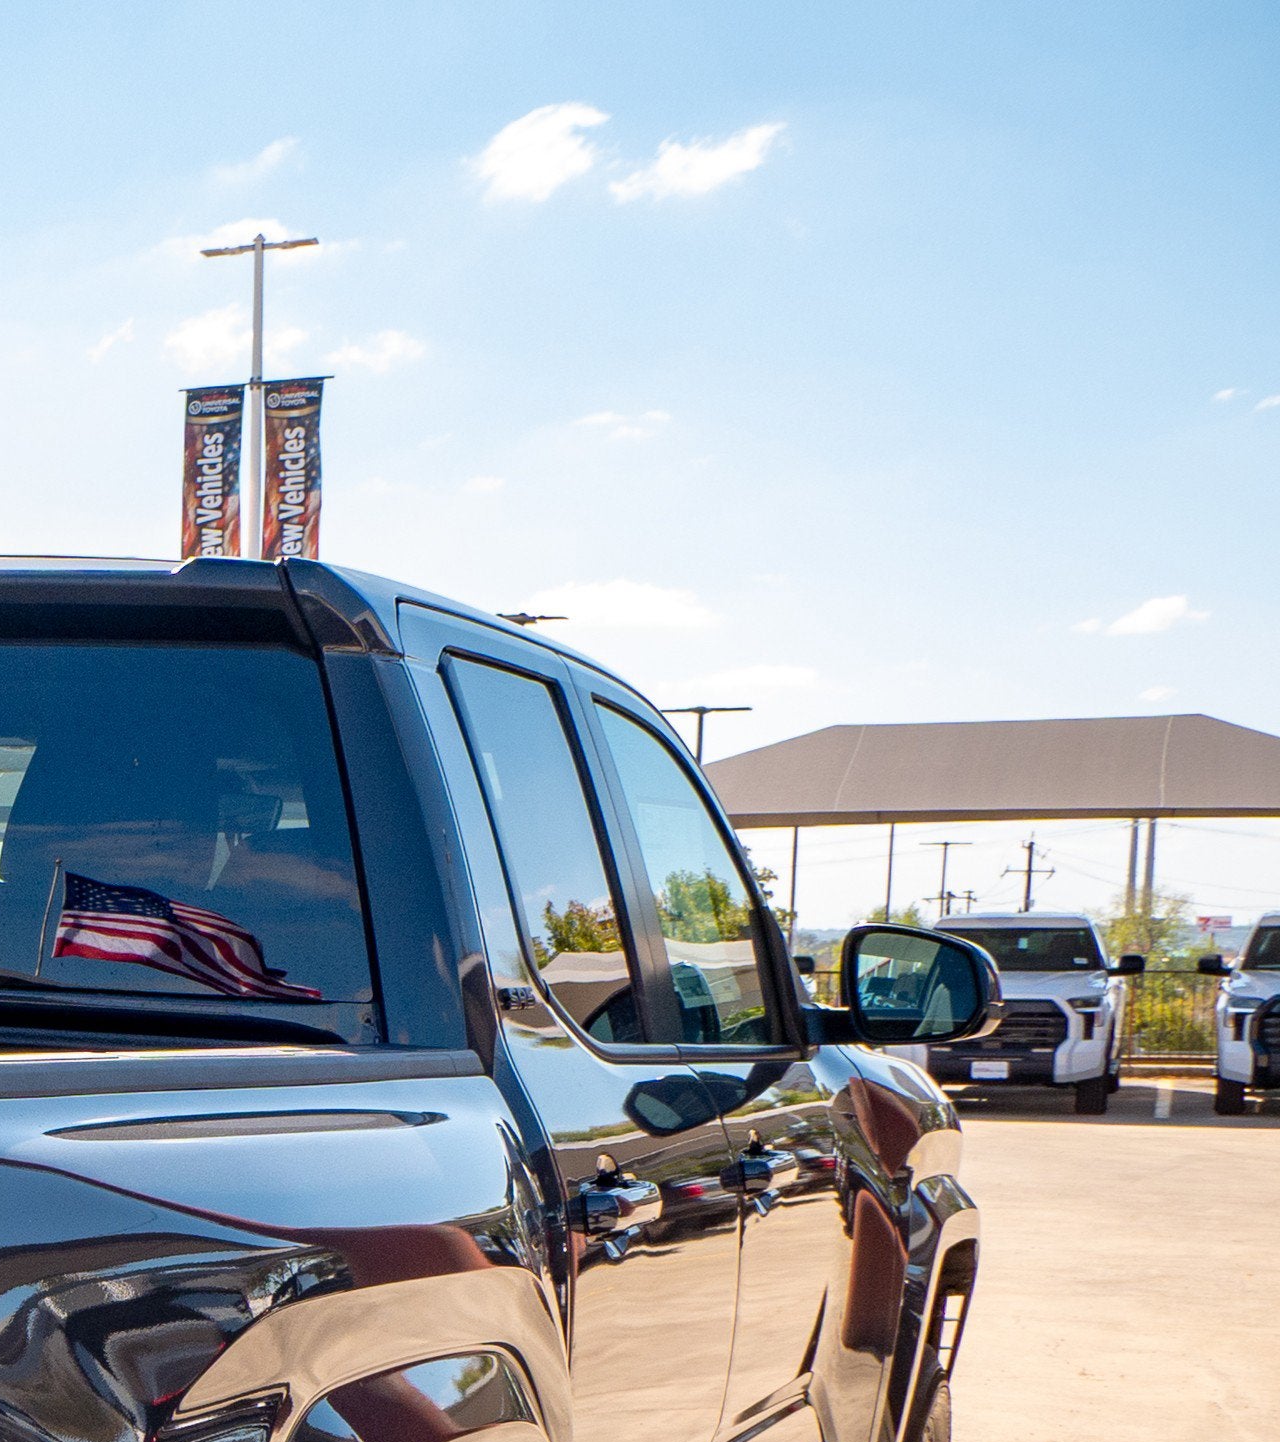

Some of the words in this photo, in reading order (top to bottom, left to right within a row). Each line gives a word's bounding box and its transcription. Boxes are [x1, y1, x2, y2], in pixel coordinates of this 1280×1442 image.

[197, 432, 224, 525] Vehicles
[278, 426, 305, 521] Vehicles
[201, 528, 223, 557] ew
[279, 524, 303, 557] ew
